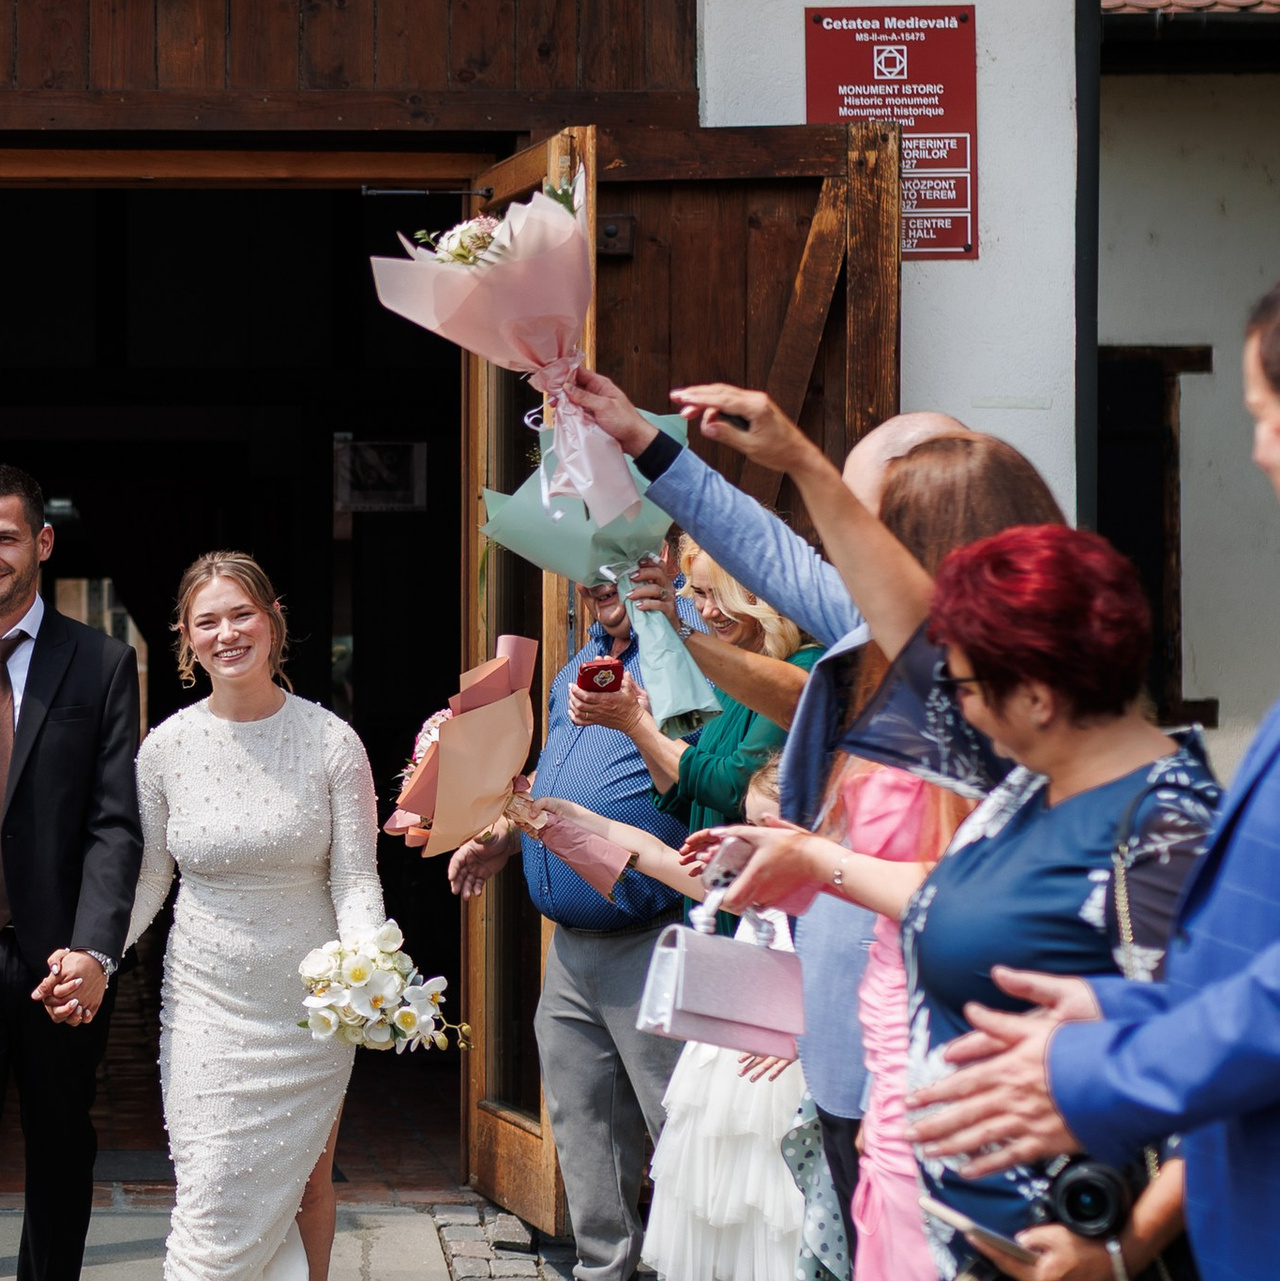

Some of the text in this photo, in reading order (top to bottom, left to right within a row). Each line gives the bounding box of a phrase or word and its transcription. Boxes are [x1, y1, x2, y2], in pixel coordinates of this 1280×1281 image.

[822, 16, 959, 30] Cetatea Medievală
[838, 84, 944, 95] MONUMENT ISTORIC
[844, 96, 939, 105] Historic monument
[838, 107, 945, 117] Monument historique
[902, 149, 948, 159] ORIILOR
[920, 190, 956, 200] TEREM
[909, 219, 952, 229] CENTRE
[908, 229, 936, 239] HALL
